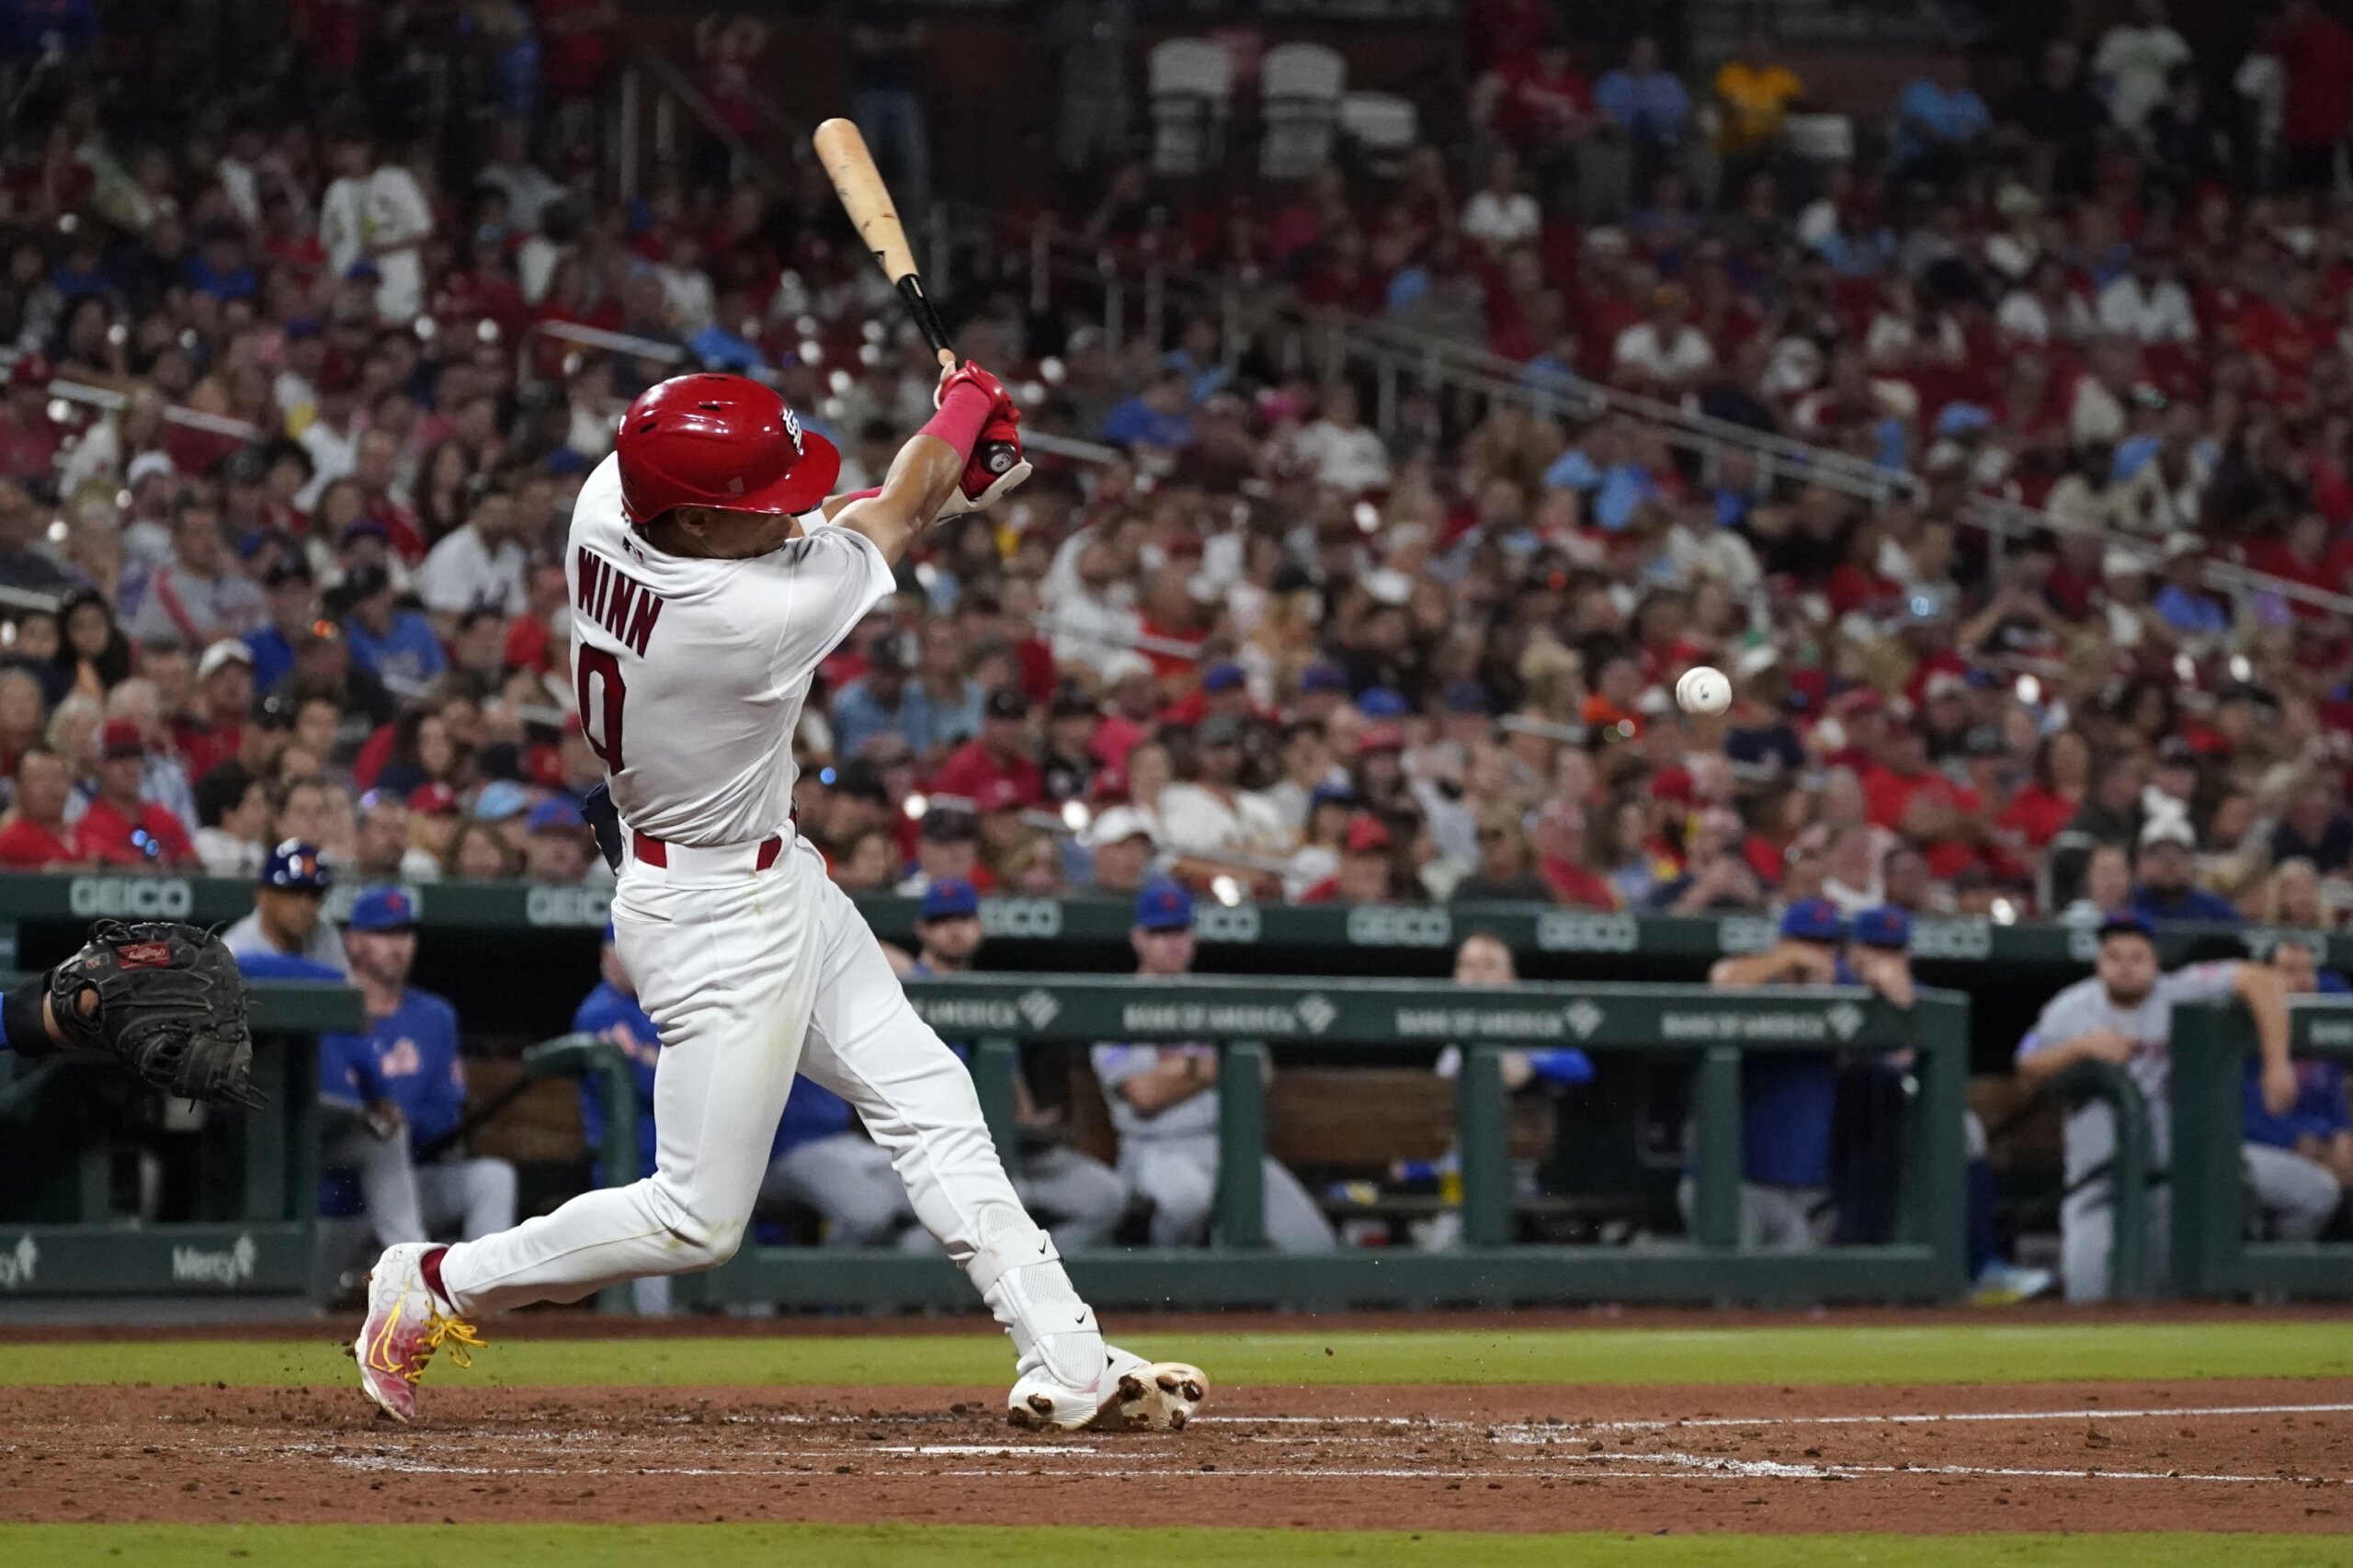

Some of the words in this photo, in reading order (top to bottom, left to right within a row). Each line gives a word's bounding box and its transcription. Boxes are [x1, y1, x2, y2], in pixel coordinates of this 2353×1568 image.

[578, 545, 664, 658] WINN
[578, 641, 627, 777] 0
[70, 878, 191, 917] GEICO
[527, 887, 613, 926] GEIC
[1347, 905, 1451, 946] GEICO
[1536, 912, 1638, 951] GEICO
[172, 1246, 237, 1287] Mercy
